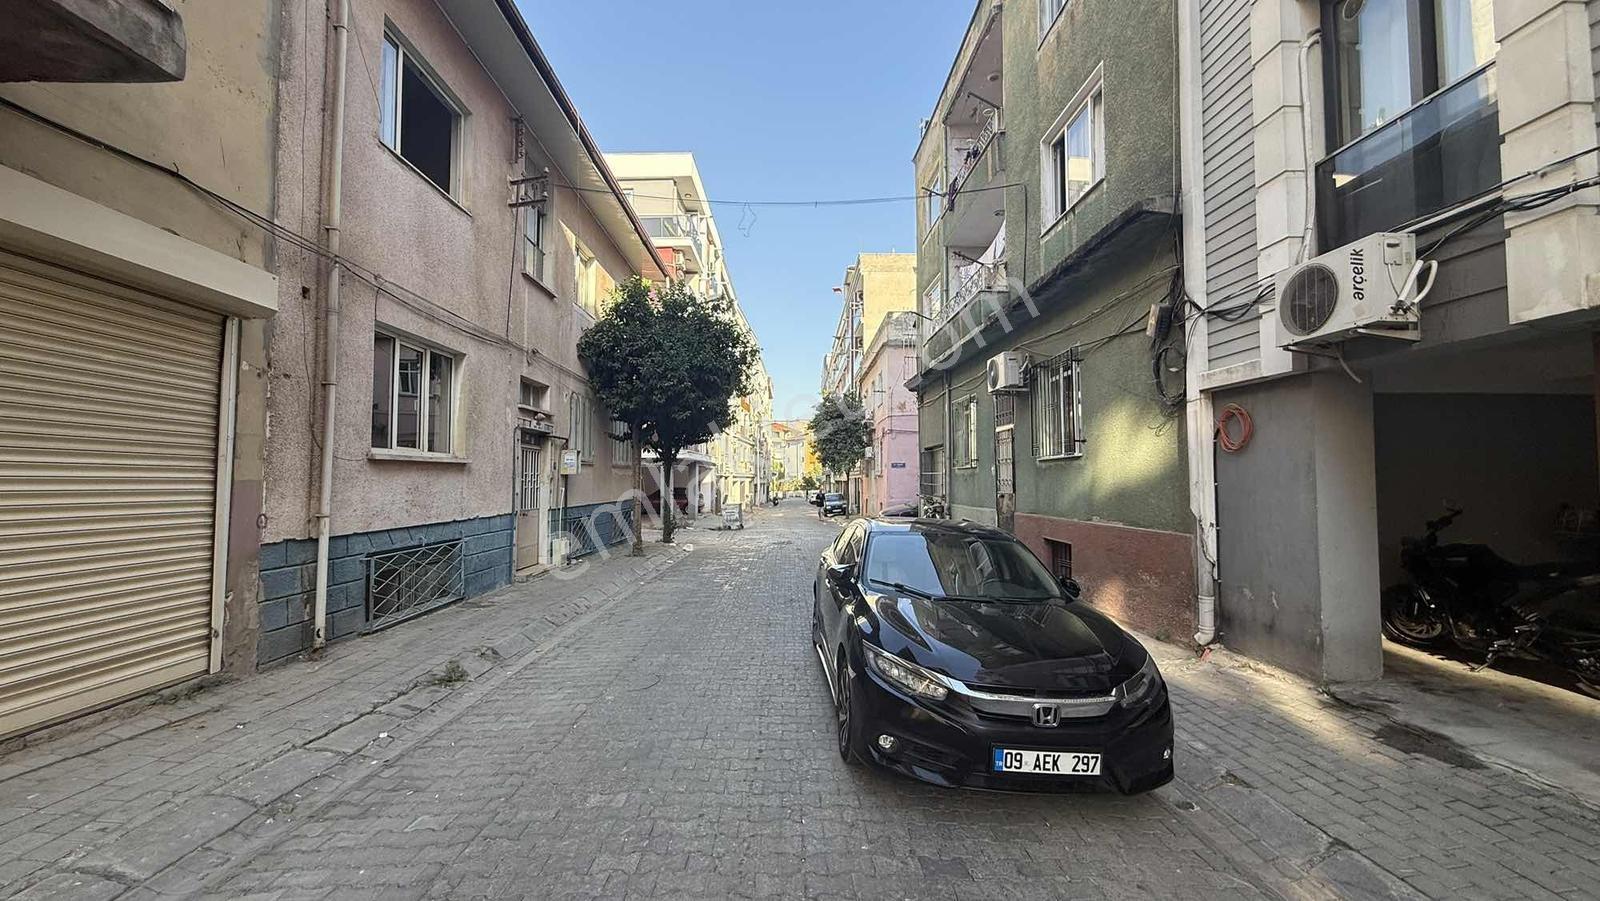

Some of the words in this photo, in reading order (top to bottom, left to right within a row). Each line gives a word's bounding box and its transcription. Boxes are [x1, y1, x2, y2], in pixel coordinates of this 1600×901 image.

[1350, 248, 1367, 301] arçelik
[1004, 752, 1023, 769] 09
[1033, 753, 1061, 772] AEK
[1071, 755, 1099, 773] 297
